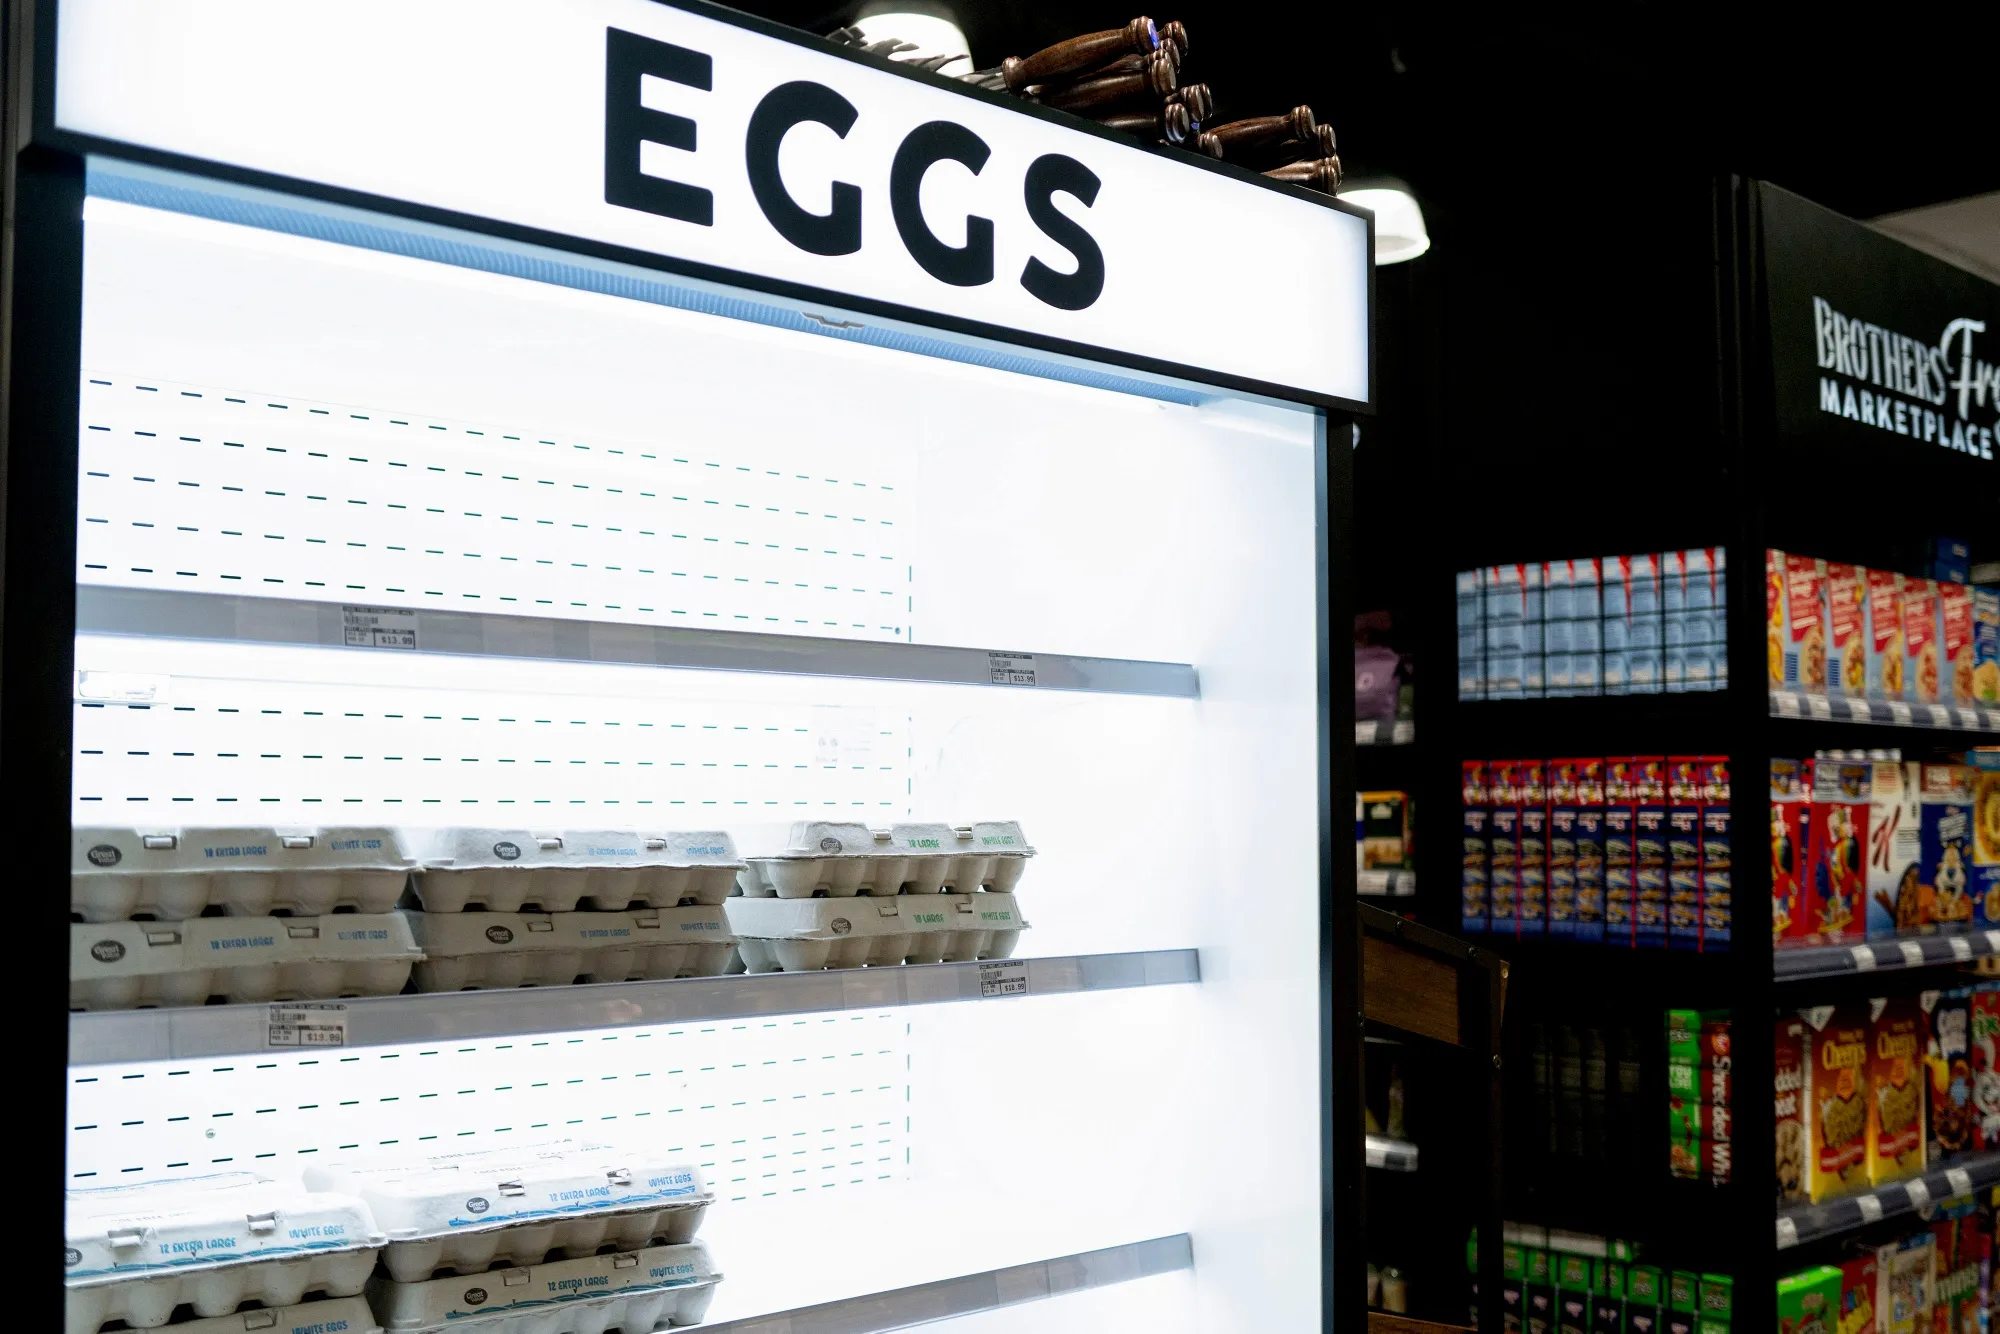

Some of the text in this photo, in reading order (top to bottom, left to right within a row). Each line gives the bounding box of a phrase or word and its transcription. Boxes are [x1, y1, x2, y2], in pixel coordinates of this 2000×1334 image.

[604, 26, 1105, 311] EGGS
[1813, 296, 1946, 406] BROTHERS
[1819, 377, 1993, 460] MARKETPLACE
[242, 845, 268, 856] LARGE
[496, 845, 516, 853] Great
[918, 839, 940, 848] LARGE
[922, 914, 944, 923] LARGE
[488, 929, 508, 938] Great
[248, 936, 274, 947] LARGE
[648, 1174, 692, 1188] WHITE EGGS
[549, 1186, 610, 1203] 12 EXTRA LARGE
[467, 1200, 487, 1208] Great
[289, 1224, 345, 1239] WHITE EGGS
[159, 1238, 236, 1254] 12 EXTRA LARGE
[650, 1264, 694, 1278] WHITE EGGS
[547, 1275, 608, 1292] 12 EXTRA LARGE
[465, 1290, 484, 1300] Great
[292, 1320, 348, 1334] WHITE EGGS
